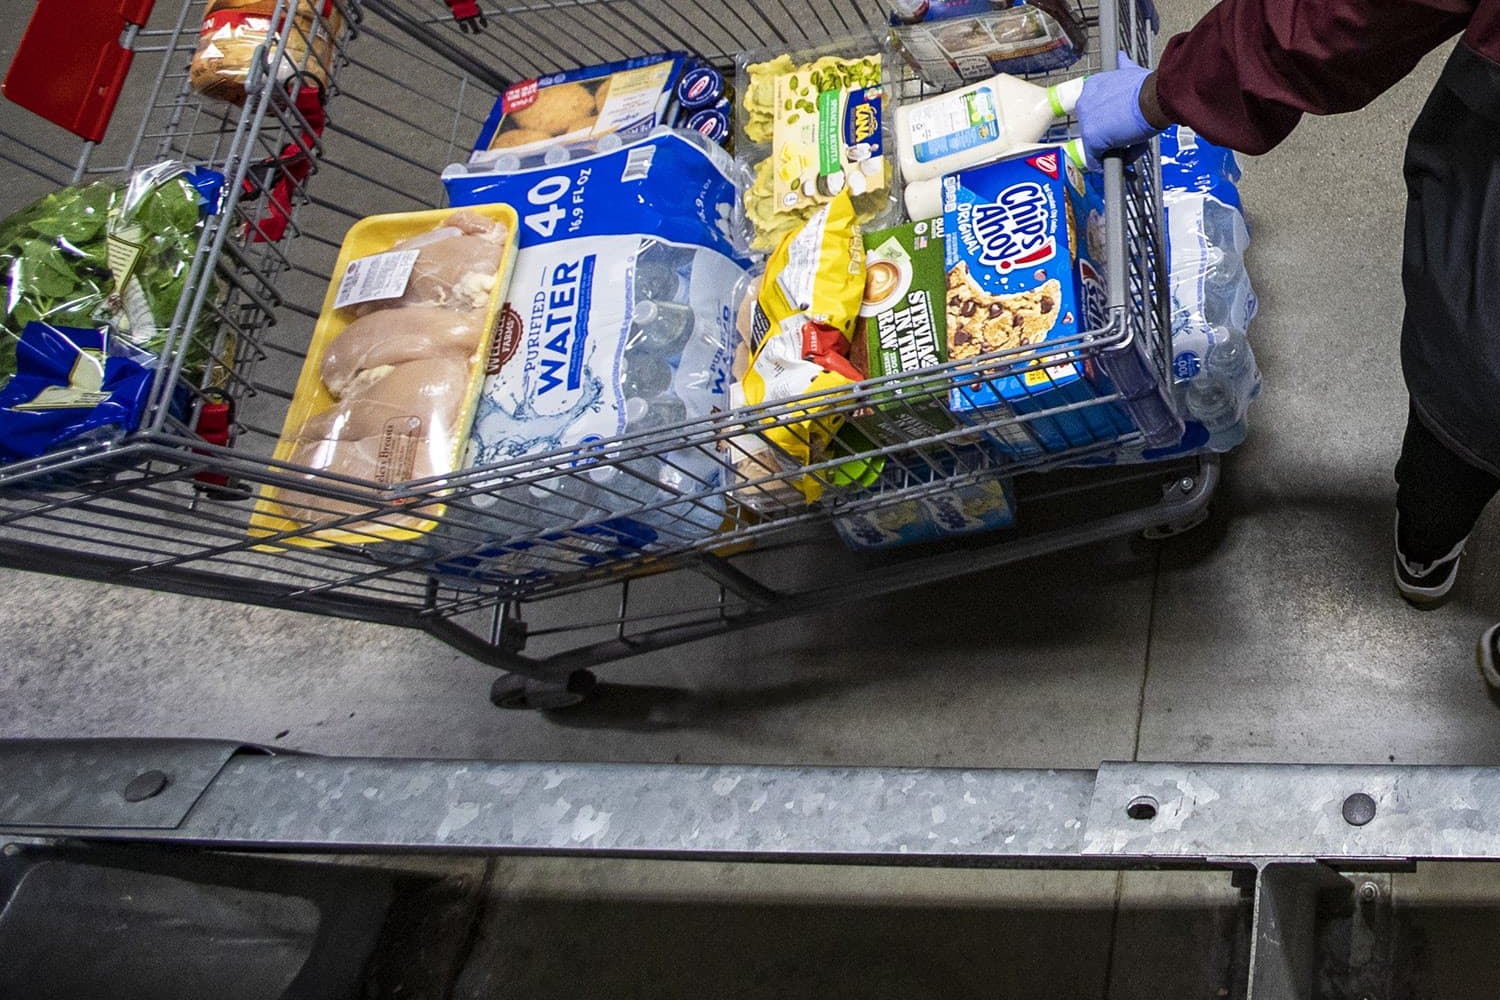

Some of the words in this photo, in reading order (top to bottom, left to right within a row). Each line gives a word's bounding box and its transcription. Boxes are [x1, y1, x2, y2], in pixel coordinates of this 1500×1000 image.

[572, 188, 586, 206] FL
[577, 167, 592, 187] OZ
[525, 175, 571, 238] 40
[567, 209, 584, 233] 16.9
[957, 202, 981, 257] ORIGINAL
[999, 184, 1045, 251] Chips
[502, 318, 515, 354] FARMS
[524, 291, 546, 373] PURIFIED
[537, 260, 580, 397] WATER
[877, 309, 898, 350] RAW
[894, 308, 912, 332] IN
[908, 290, 936, 362] STEVIA
